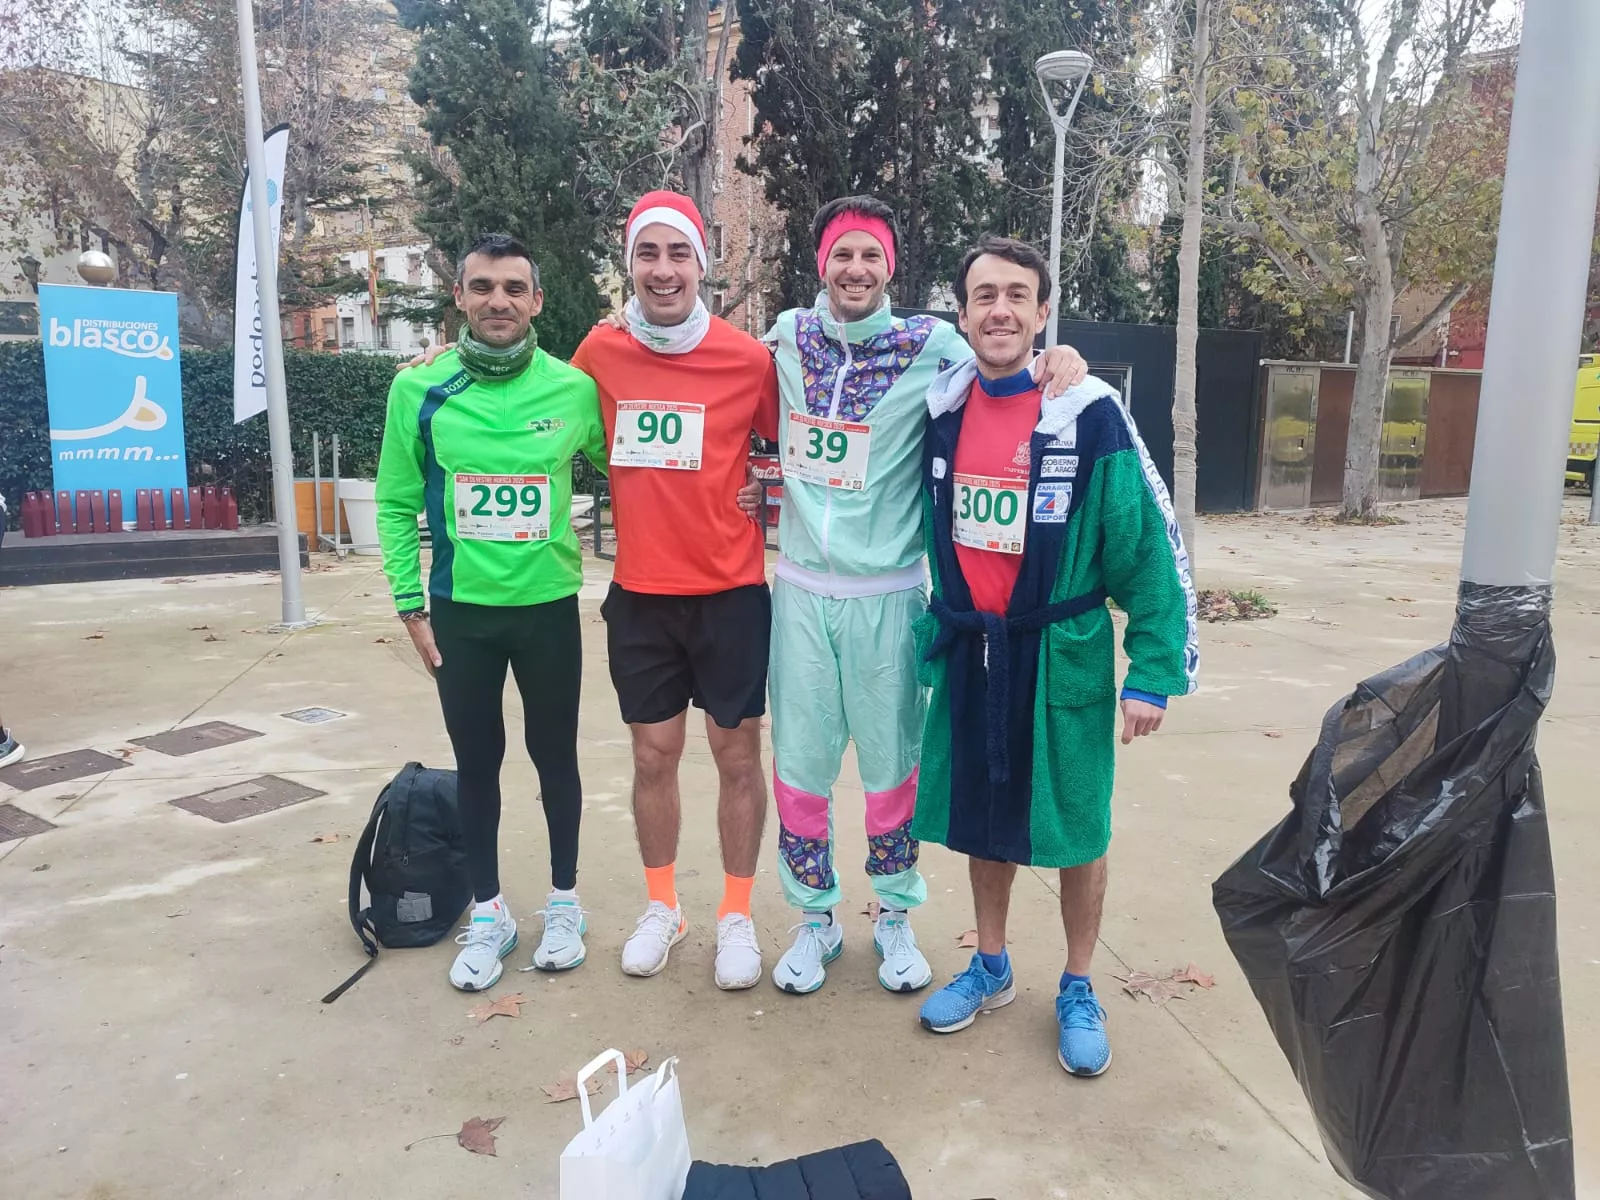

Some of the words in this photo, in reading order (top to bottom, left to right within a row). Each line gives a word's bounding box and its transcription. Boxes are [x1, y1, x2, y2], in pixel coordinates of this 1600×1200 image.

[49, 317, 160, 351] blasco
[82, 319, 159, 331] DISTRIBUCIONES
[637, 411, 683, 444] 90
[806, 427, 848, 463] 39
[1042, 458, 1077, 466] GOBIERNO
[470, 484, 541, 517] 299
[959, 485, 1018, 526] 300
